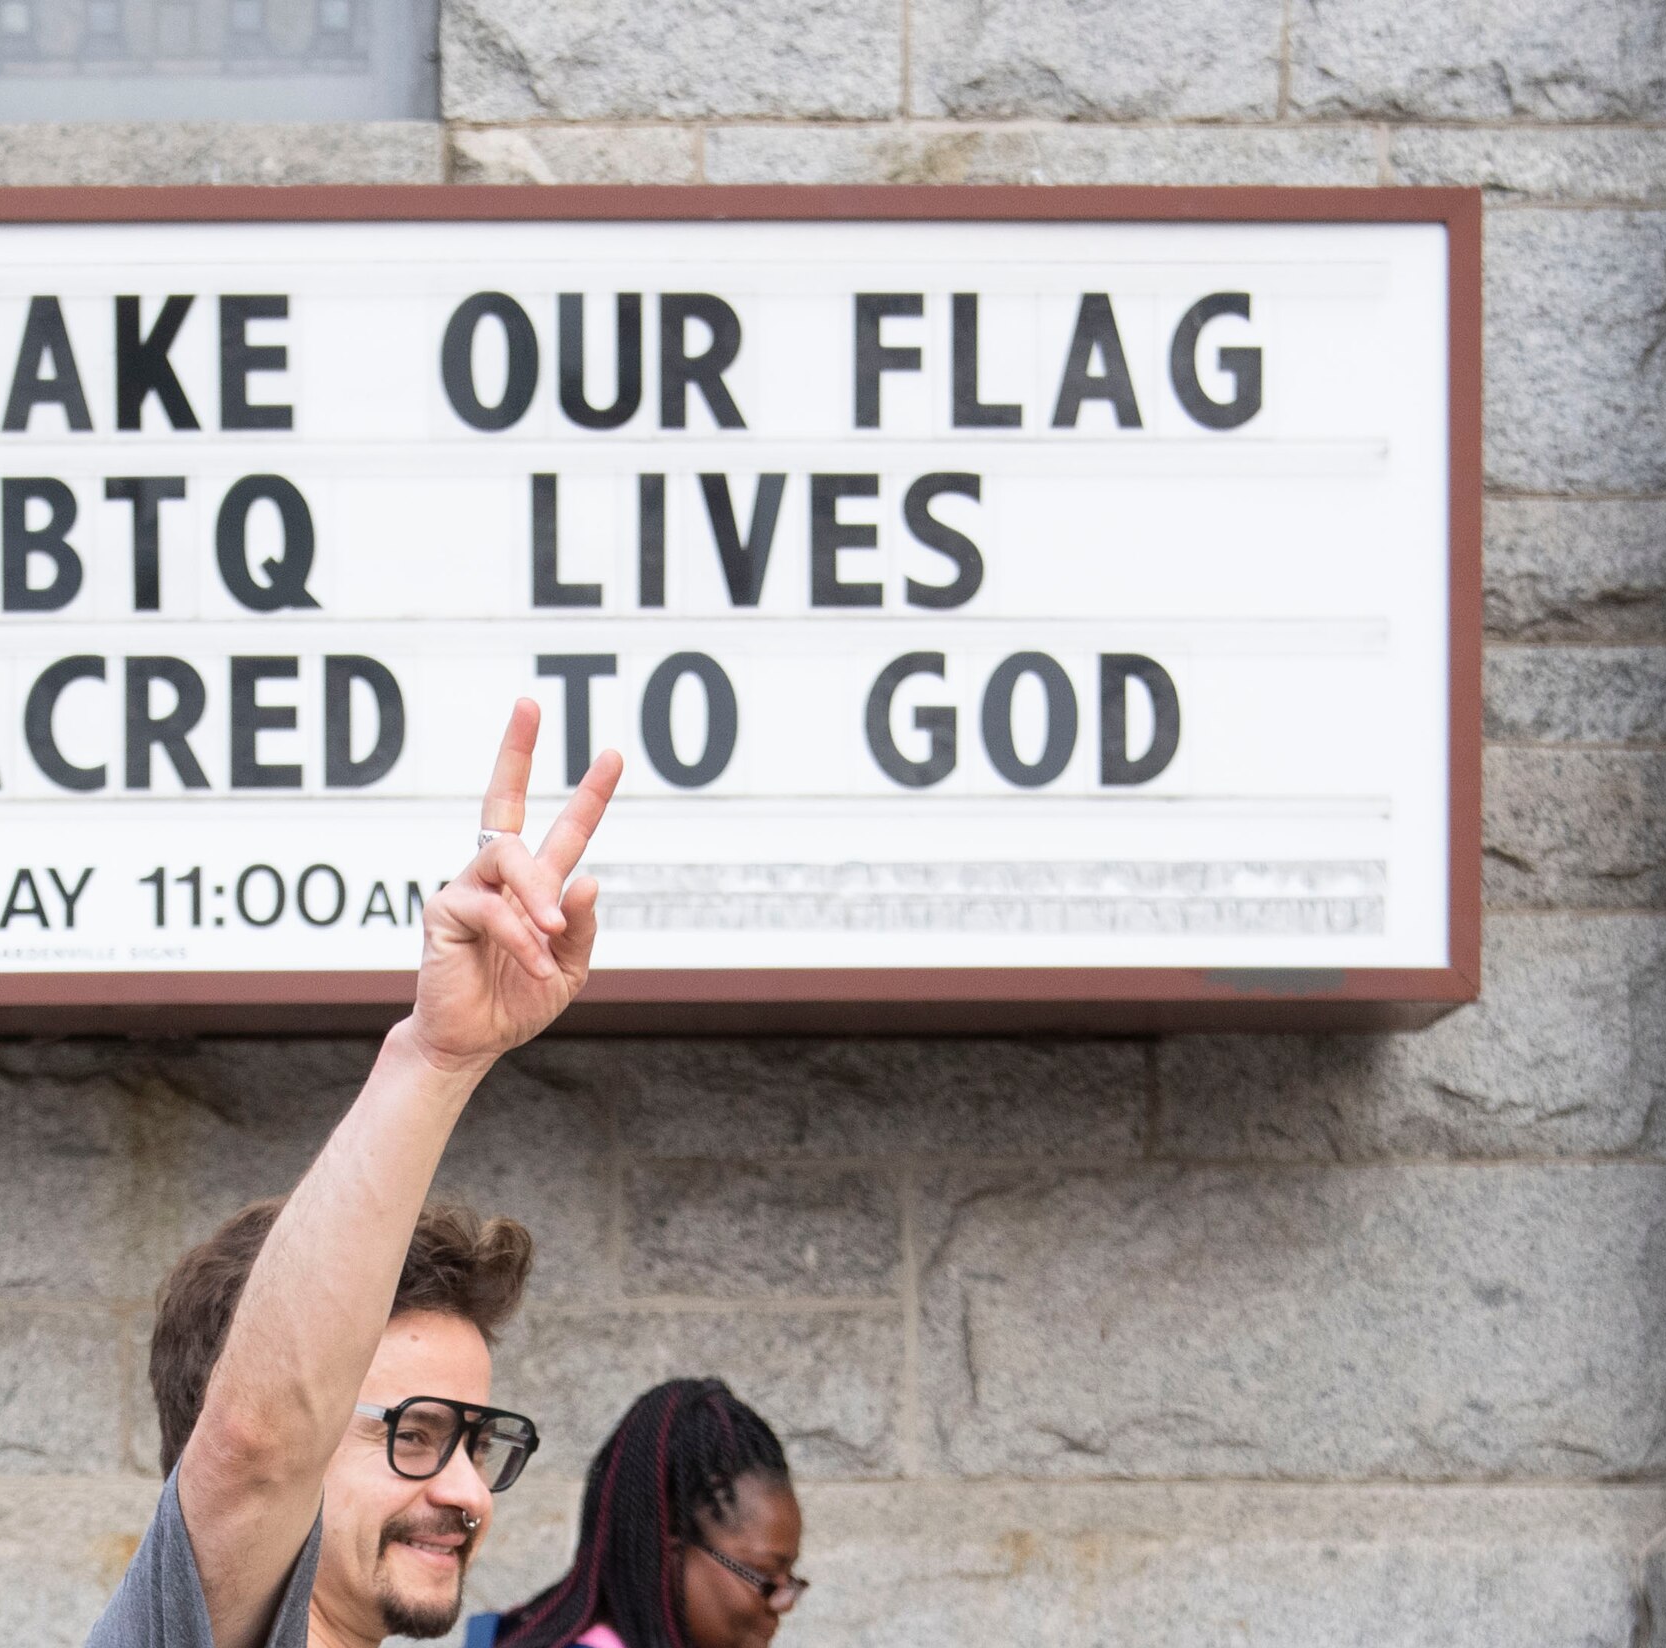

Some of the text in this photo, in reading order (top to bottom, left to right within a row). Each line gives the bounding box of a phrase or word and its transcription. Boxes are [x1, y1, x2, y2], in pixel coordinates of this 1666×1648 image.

[441, 291, 747, 432] OUR
[855, 292, 1262, 430] FLAG
[532, 472, 984, 610] LIVES
[537, 651, 738, 788] TO
[865, 651, 1181, 788] GOD
